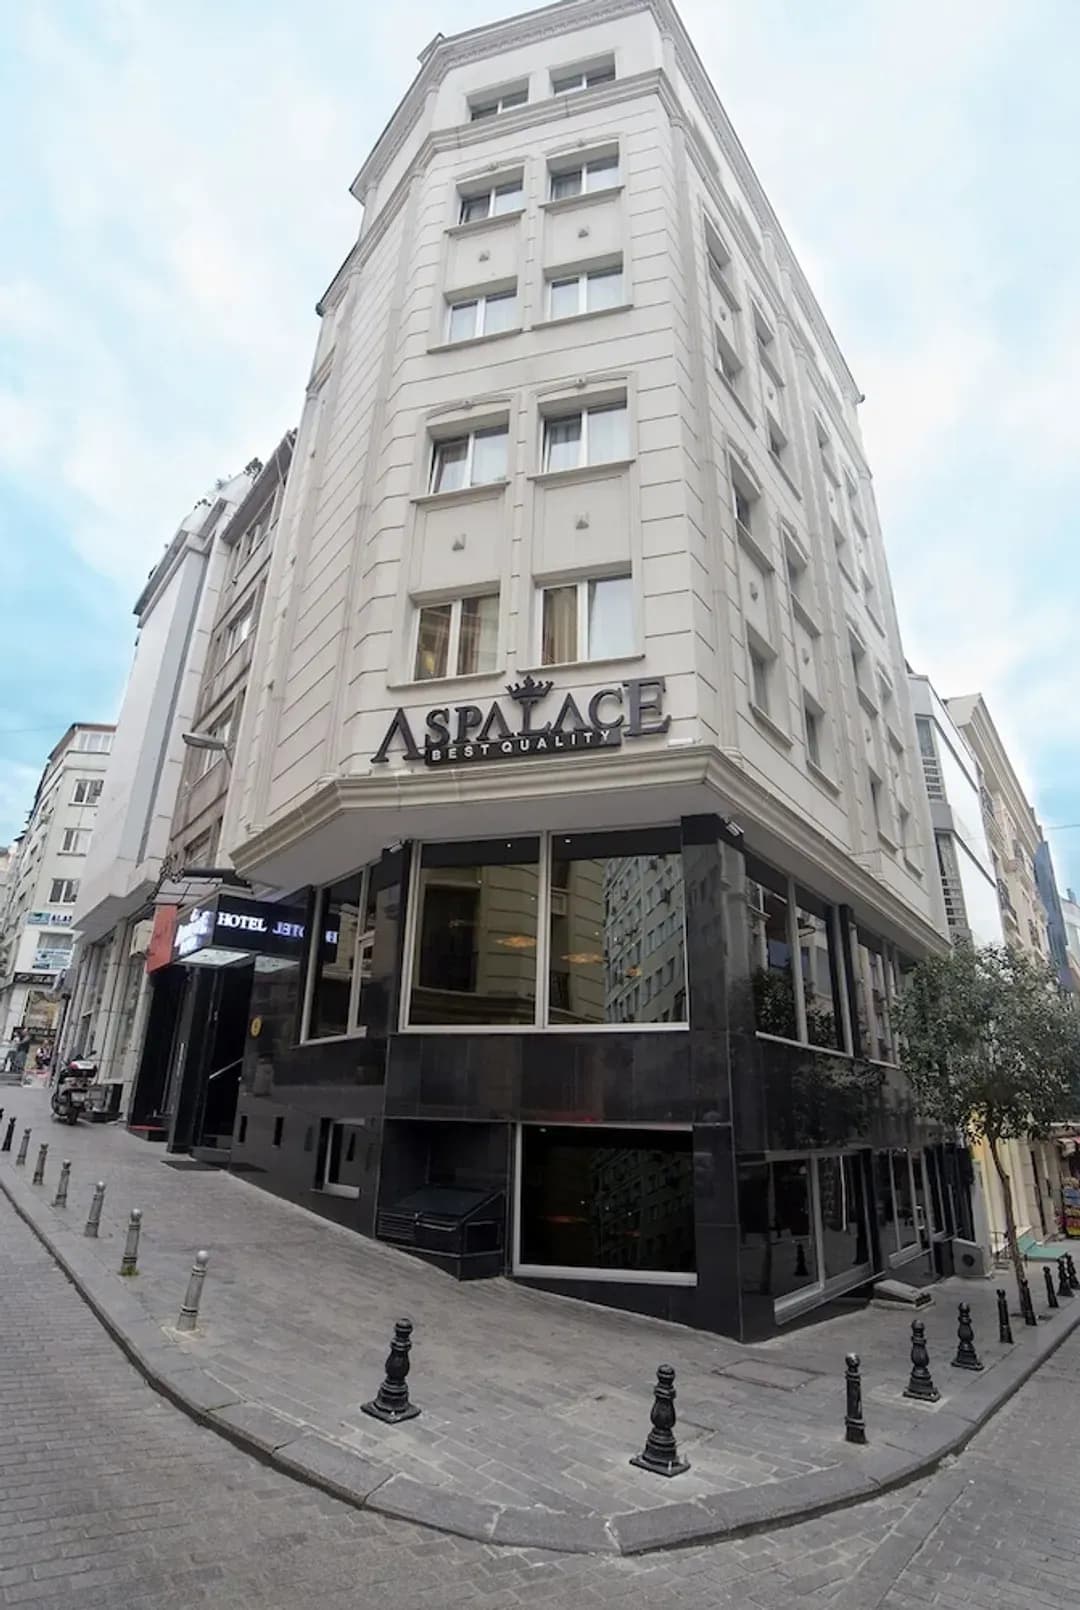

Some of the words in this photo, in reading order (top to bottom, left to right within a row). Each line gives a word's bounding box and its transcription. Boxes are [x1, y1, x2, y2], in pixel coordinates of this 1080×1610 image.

[431, 744, 490, 761] BEST
[502, 730, 610, 752] QUALITY
[217, 912, 267, 932] HOTEL
